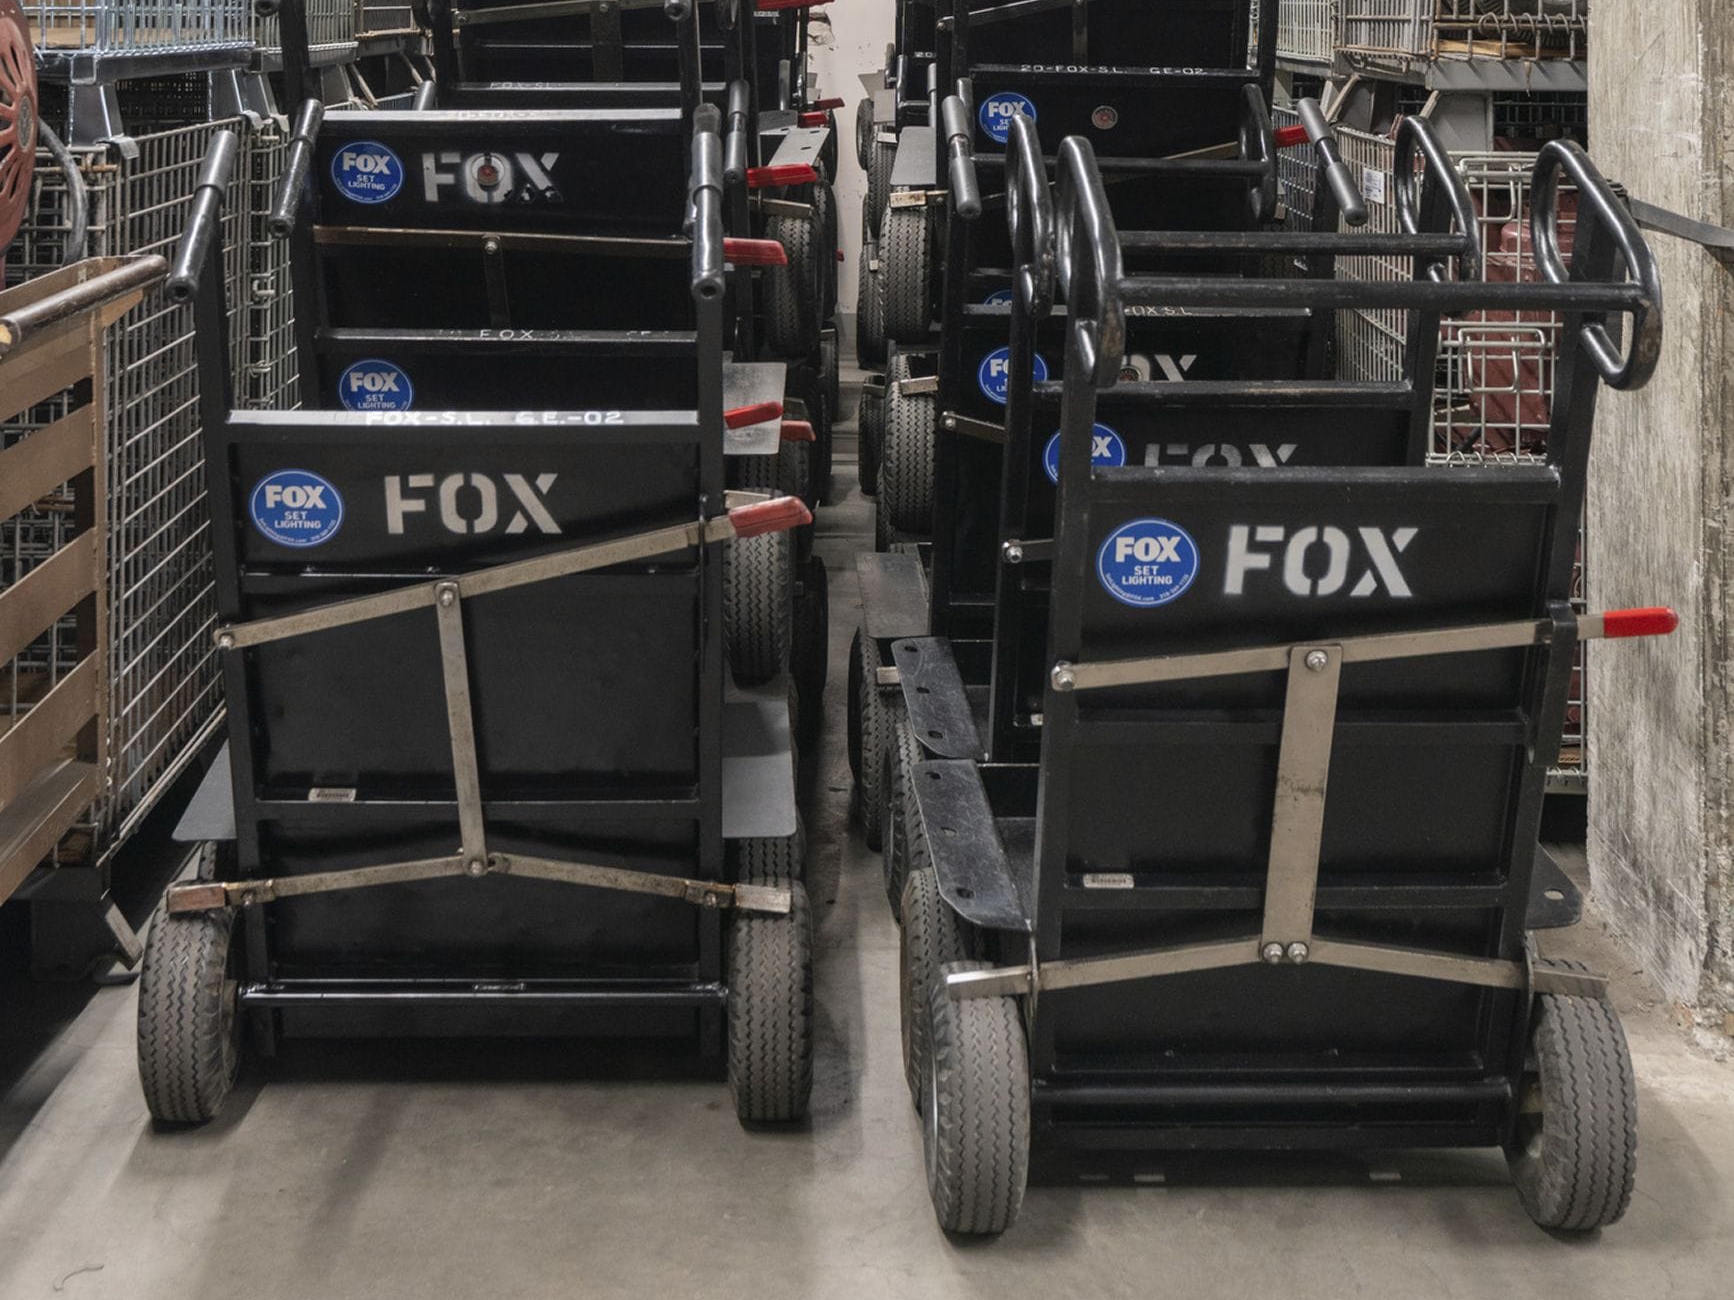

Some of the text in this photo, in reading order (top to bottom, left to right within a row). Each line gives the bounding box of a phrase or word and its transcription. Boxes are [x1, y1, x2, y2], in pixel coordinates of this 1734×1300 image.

[988, 101, 1026, 118] FOX
[343, 152, 391, 175] FOX
[348, 180, 386, 191] LIGHTING
[356, 174, 375, 182] SET
[422, 152, 564, 203] FOX
[349, 372, 400, 392] FOX
[365, 394, 384, 402] SET
[265, 485, 327, 509] FOX
[385, 473, 562, 536] FOX
[284, 511, 307, 520] SET
[274, 520, 321, 529] LIGHTING
[1115, 536, 1181, 563] FOX
[1223, 524, 1418, 598] FOX
[1134, 565, 1159, 576] SET
[1121, 575, 1173, 585] LIGHTING
